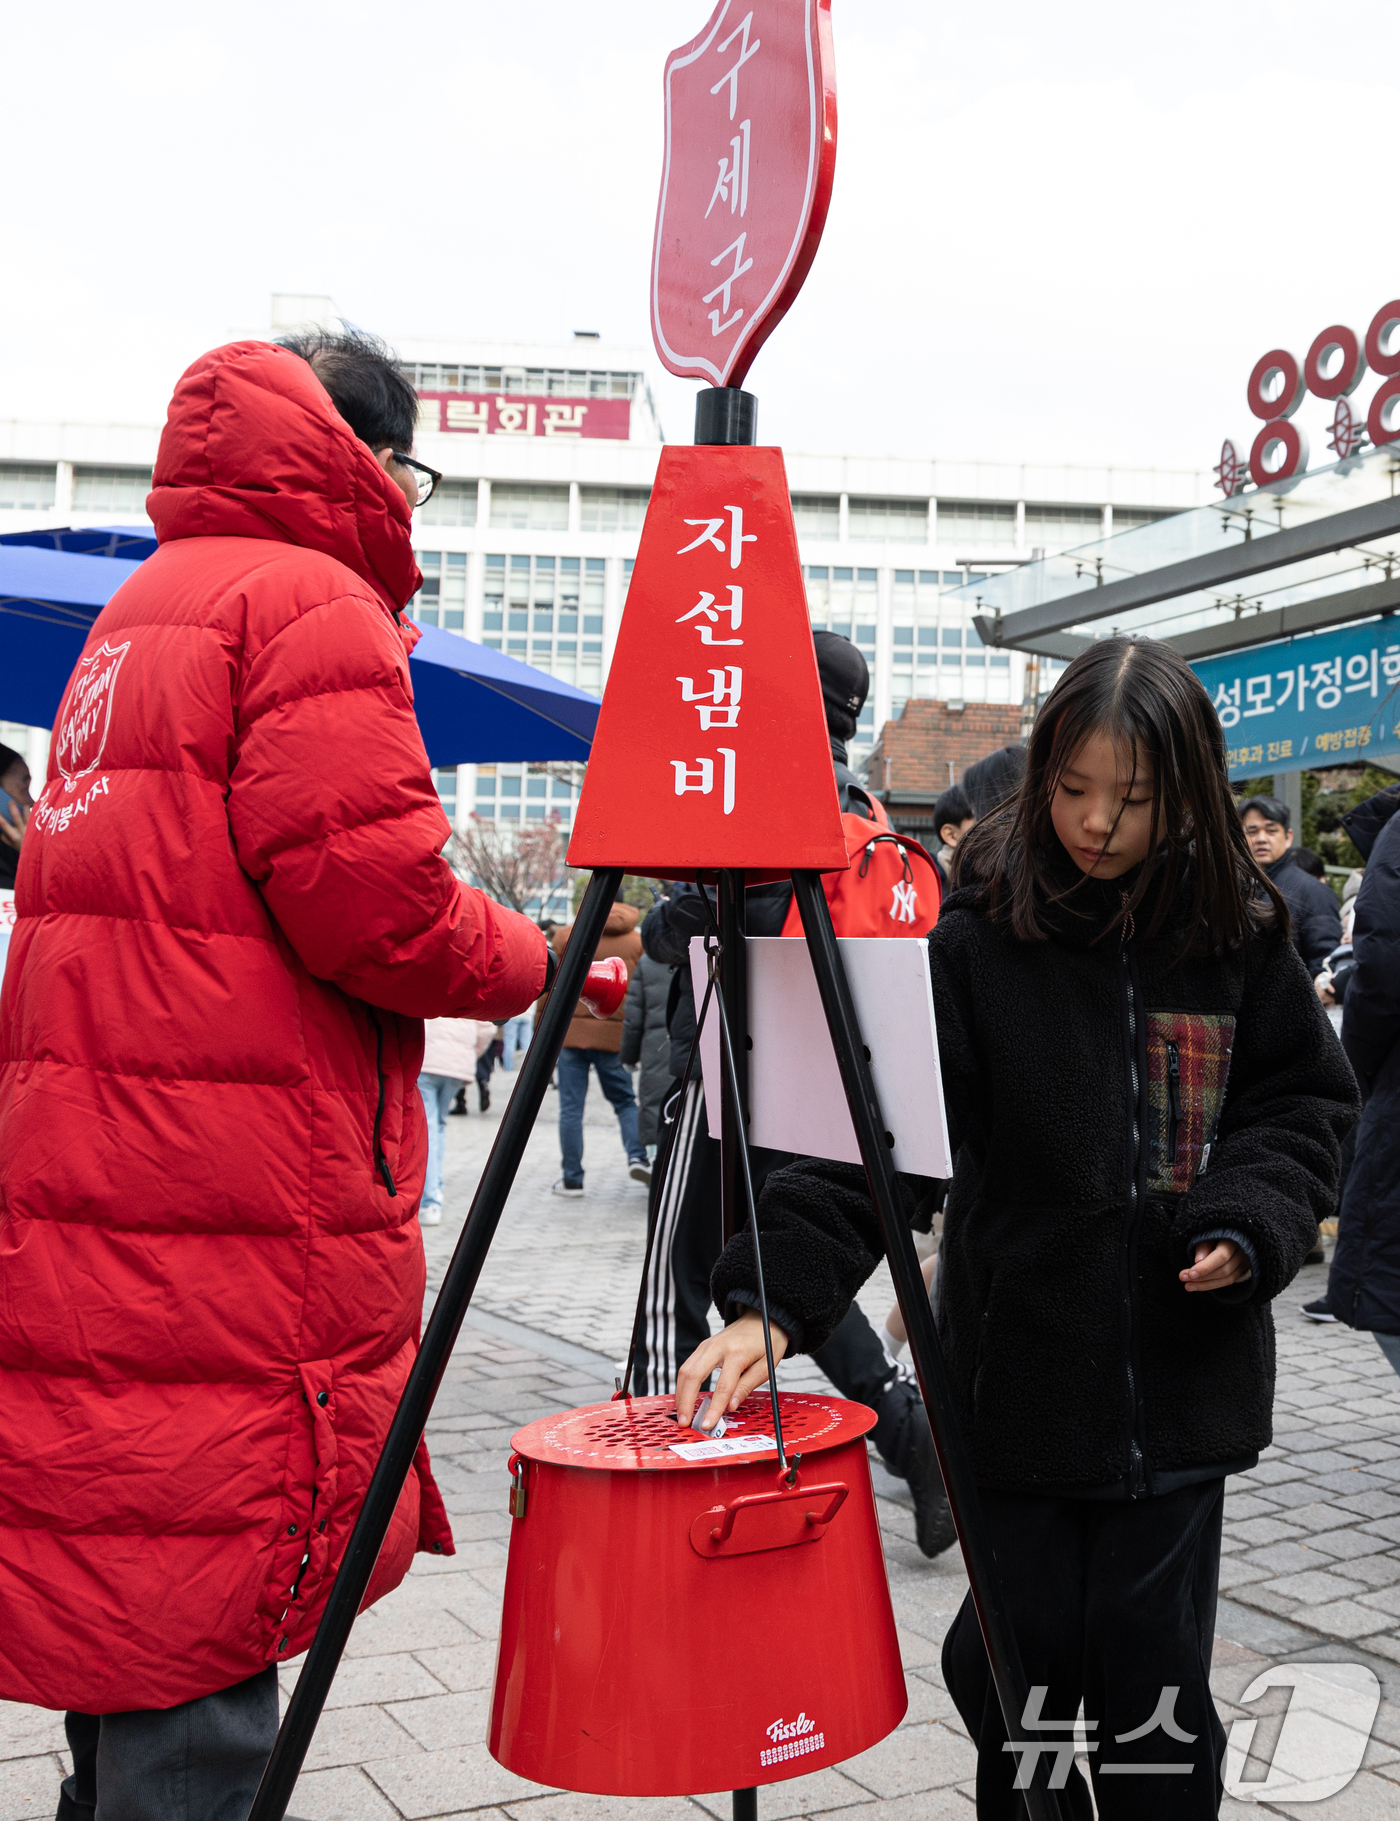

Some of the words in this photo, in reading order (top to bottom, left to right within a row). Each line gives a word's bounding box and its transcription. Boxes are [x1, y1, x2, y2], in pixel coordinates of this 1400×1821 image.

[702, 11, 761, 337] 구세군
[670, 505, 758, 815] 자선냄비
[1267, 740, 1293, 762] 진료
[766, 1712, 815, 1743] Fissler
